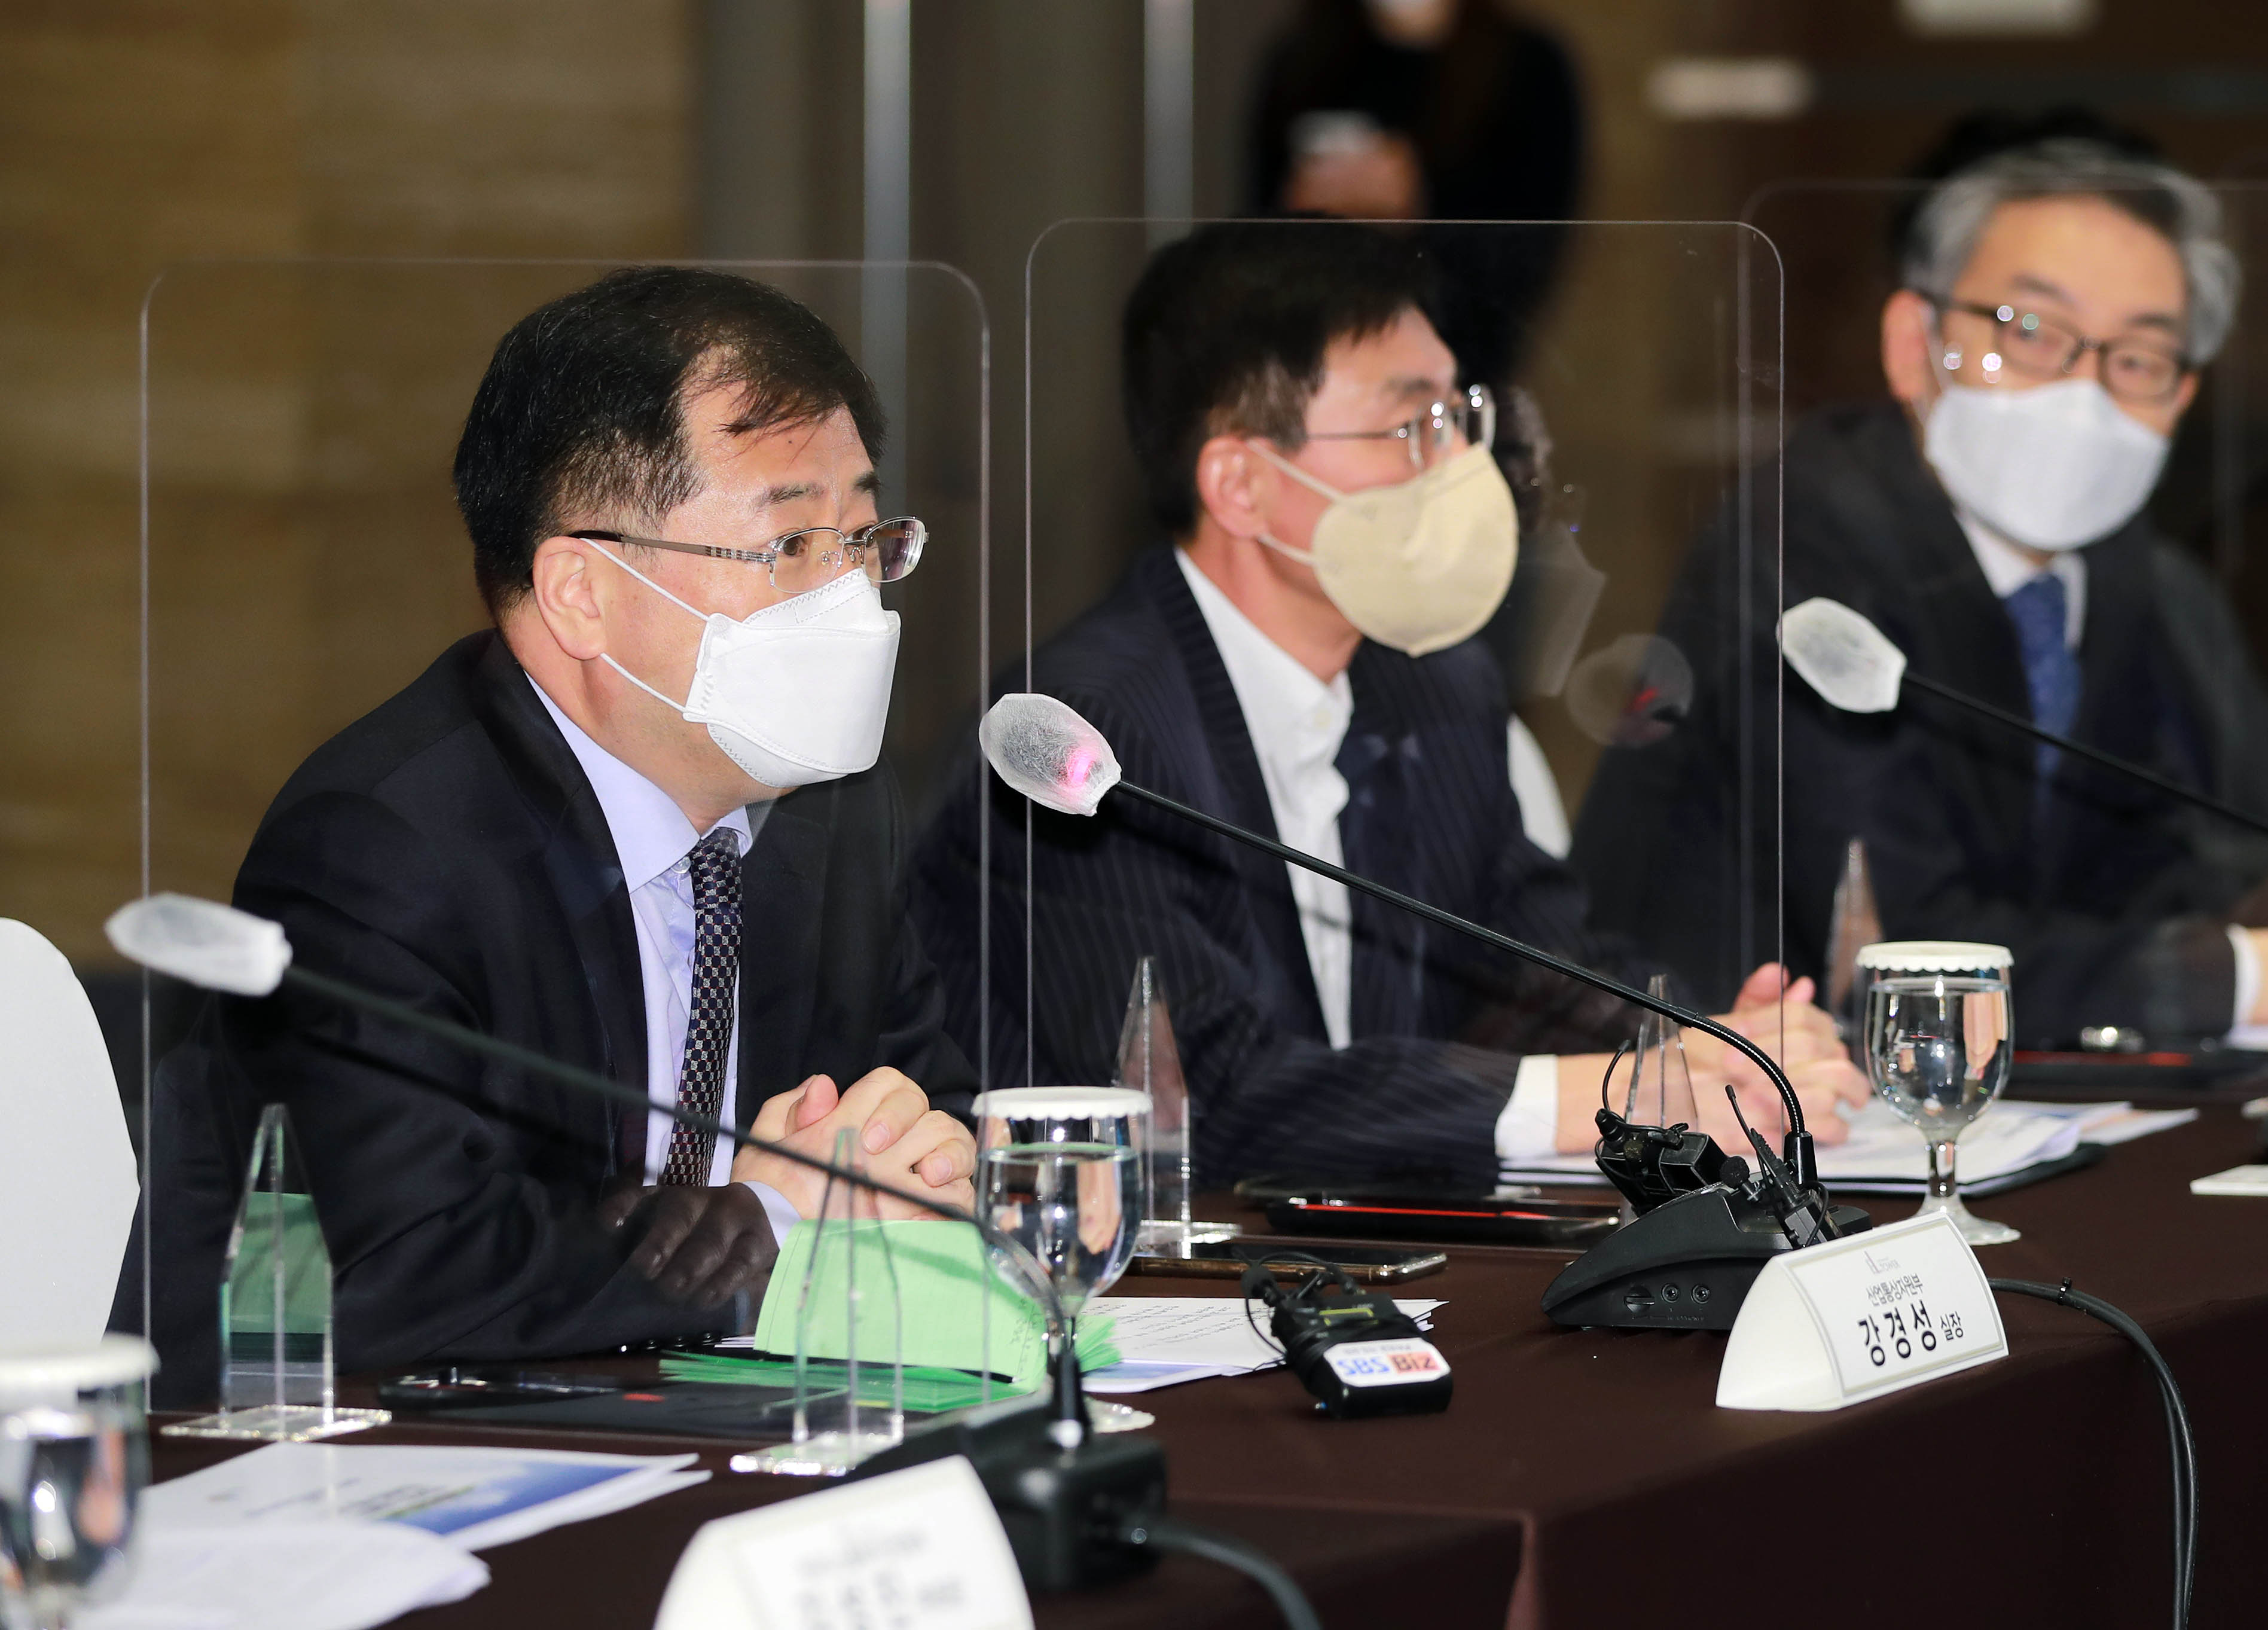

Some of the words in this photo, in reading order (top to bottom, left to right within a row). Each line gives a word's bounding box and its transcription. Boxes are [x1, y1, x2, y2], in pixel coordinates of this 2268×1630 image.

[1866, 1273, 1923, 1306] 산업통상자원부
[1858, 1299, 1937, 1366] 강경성
[1940, 1311, 1964, 1341] 실장
[1338, 1356, 1390, 1375] SBS
